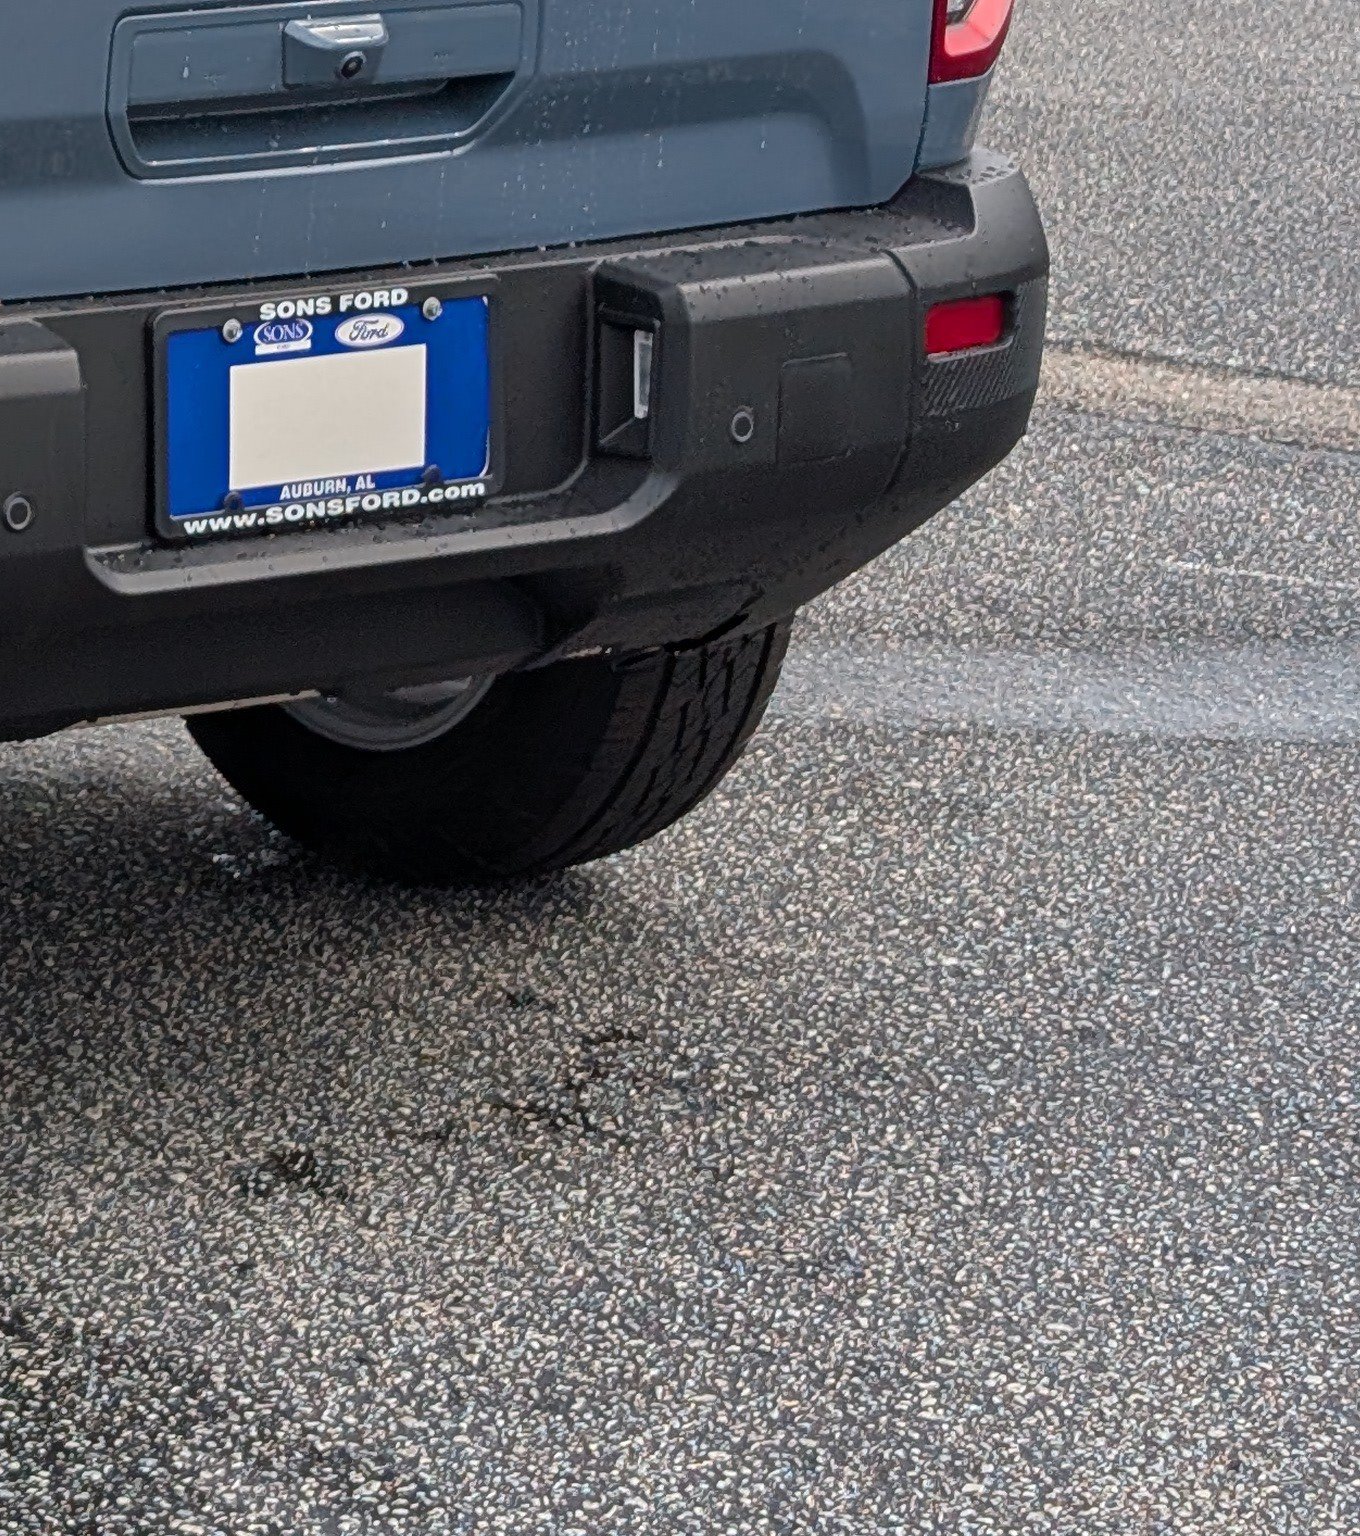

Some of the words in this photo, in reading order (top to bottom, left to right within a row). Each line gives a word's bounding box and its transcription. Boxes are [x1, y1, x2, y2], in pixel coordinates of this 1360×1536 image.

[260, 297, 332, 321] SONS
[339, 288, 409, 312] FORD
[263, 324, 305, 342] SONS
[348, 319, 389, 342] Ford
[280, 476, 351, 501] AUBURN,
[355, 474, 376, 490] AL
[184, 481, 486, 535] www.SONSFORD.com
